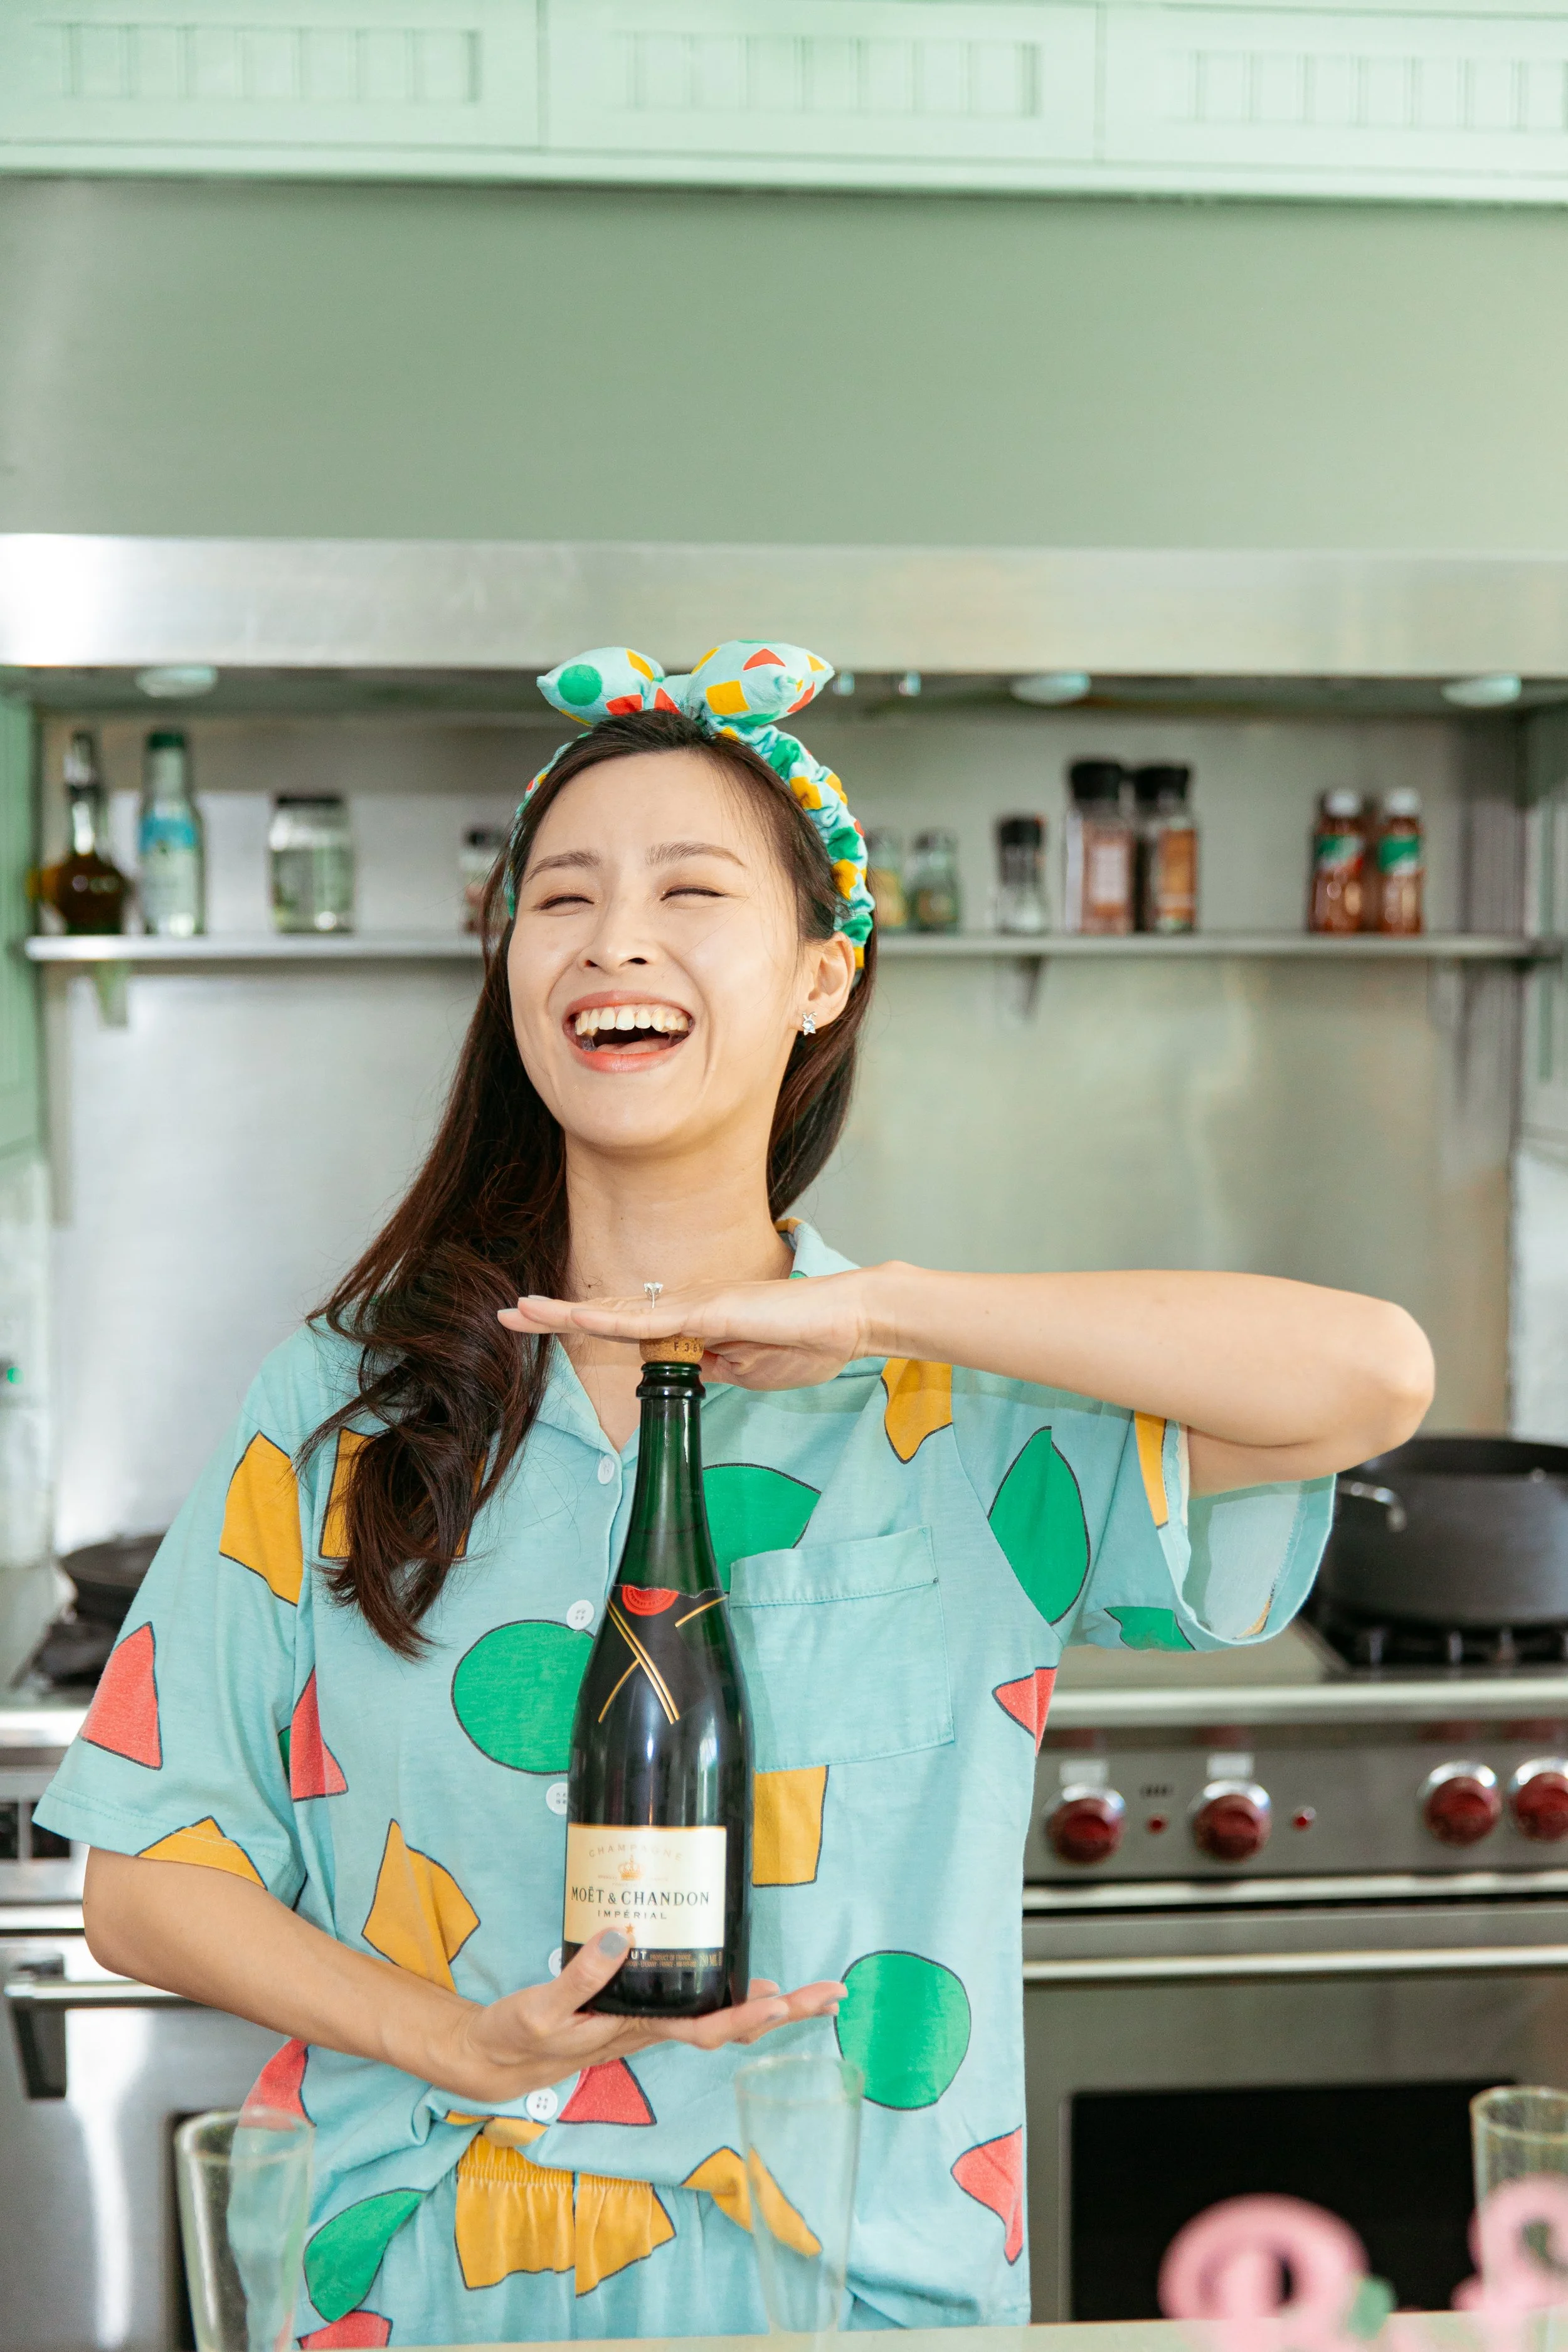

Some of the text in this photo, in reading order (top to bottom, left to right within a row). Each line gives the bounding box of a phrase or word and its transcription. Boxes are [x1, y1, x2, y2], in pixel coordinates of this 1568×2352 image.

[589, 1843, 682, 1861] CHAMPAGNE
[571, 1886, 709, 1906] MOËT & CHANDON
[598, 1910, 667, 1920] IMPÉRIAL
[630, 1949, 647, 1961] UT
